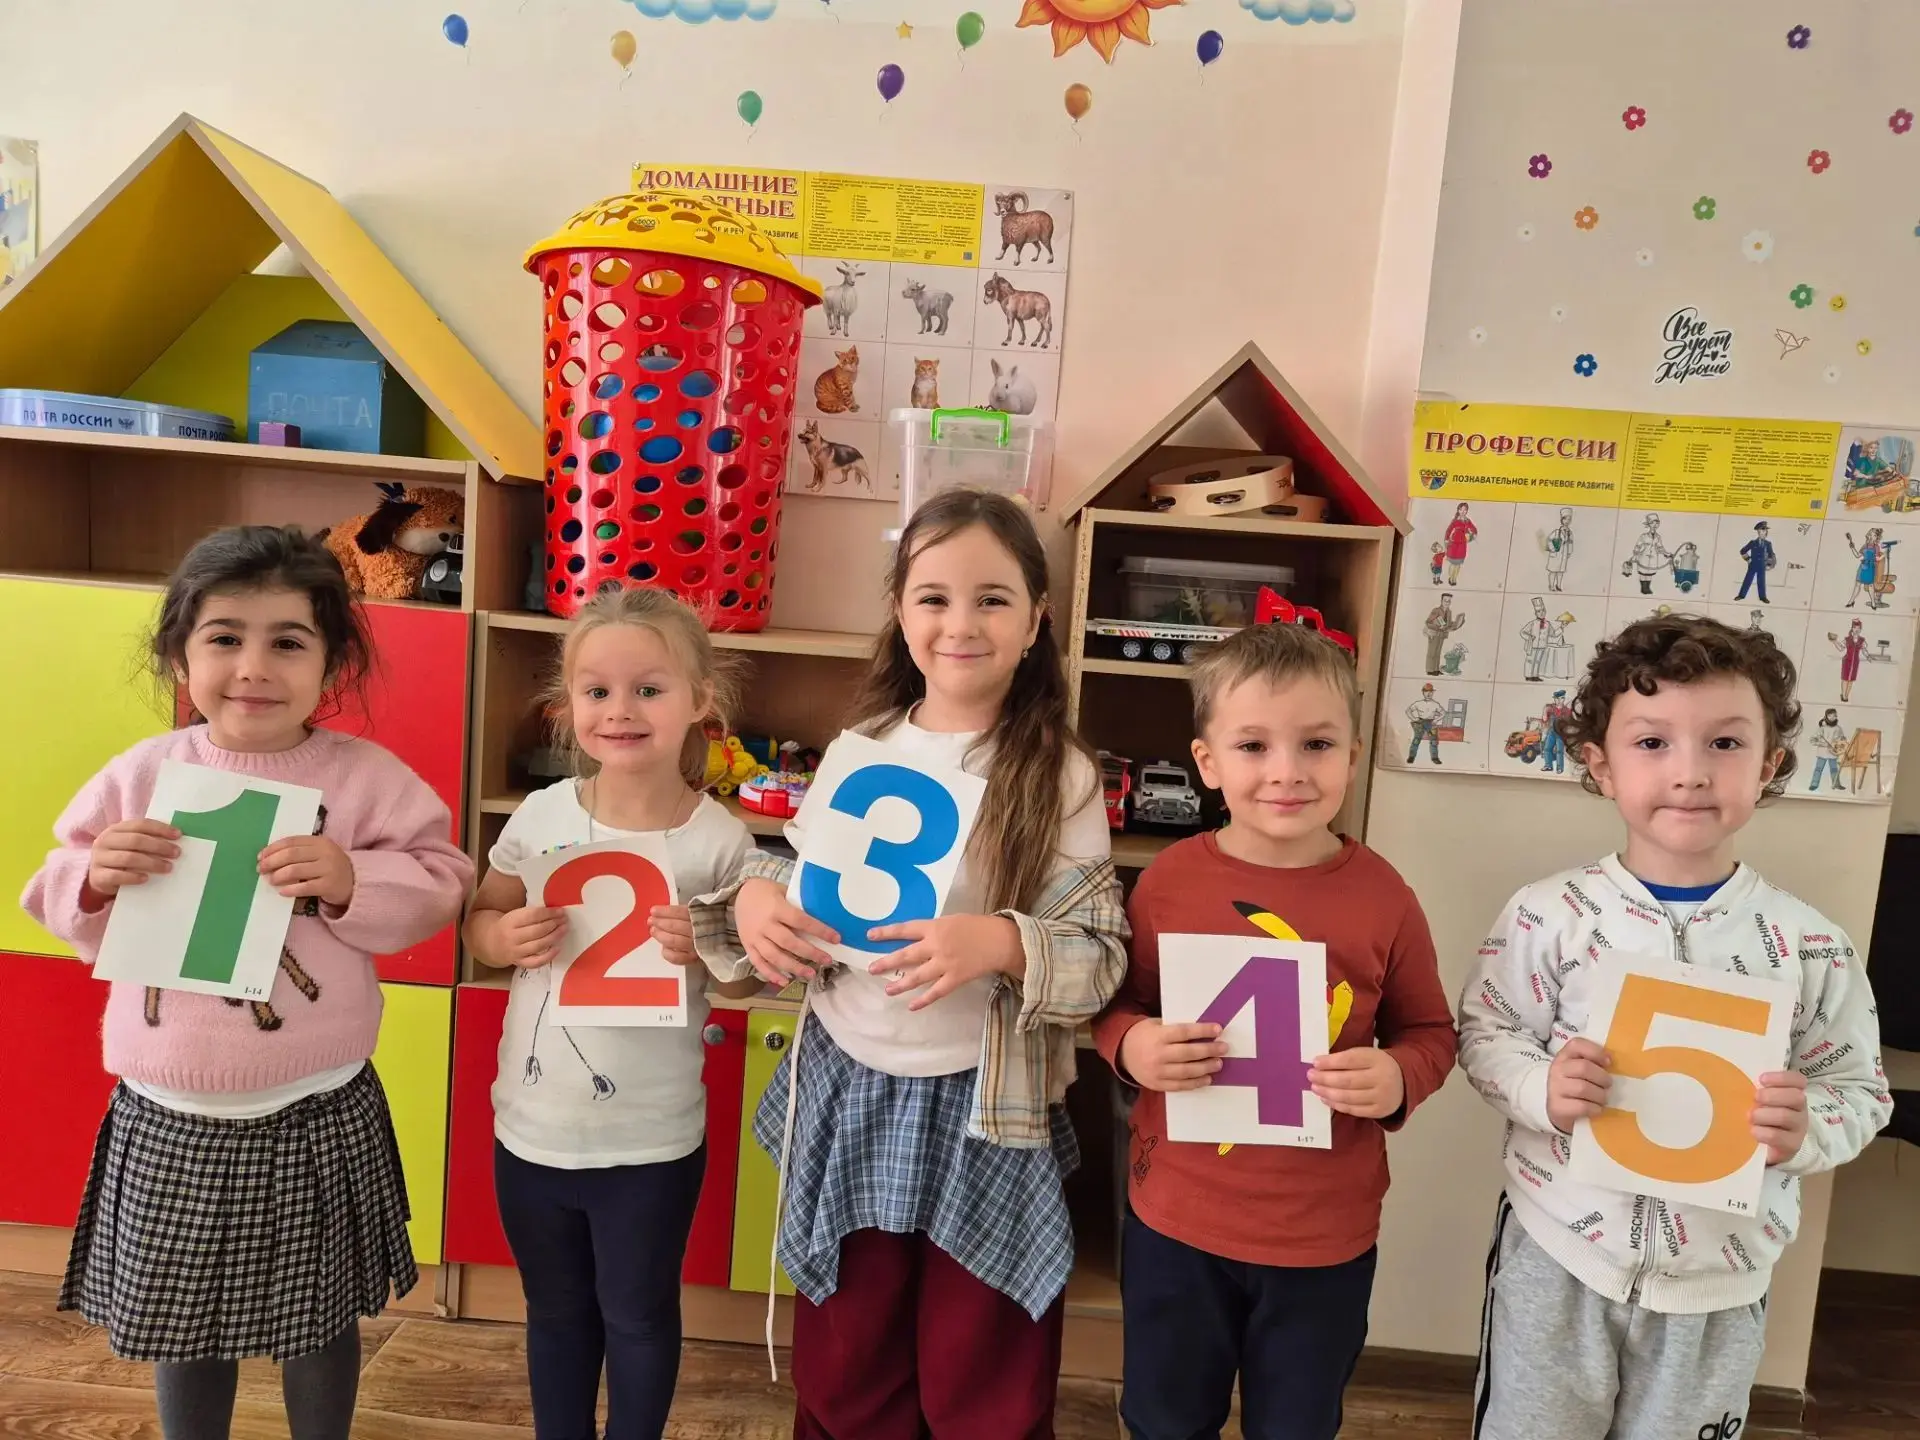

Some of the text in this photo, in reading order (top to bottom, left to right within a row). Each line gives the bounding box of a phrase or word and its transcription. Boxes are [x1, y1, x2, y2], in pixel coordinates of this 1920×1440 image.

[638, 170, 799, 197] ДОМАШНИЕ
[62, 413, 113, 427] РОССИИ
[178, 425, 207, 439] ПОЧТА
[1425, 432, 1617, 462] ПРОФЕССИИ
[1452, 475, 1528, 486] ПОЗНАВАТЕЛЬНОЕ
[1539, 479, 1575, 488] РЕЧЕВОЕ
[1577, 481, 1615, 491] РАЗВИТИЕ
[800, 763, 960, 954] 3
[169, 788, 281, 984] 1
[1564, 879, 1603, 917] MOSCHINO
[1561, 892, 1584, 918] Milano
[1625, 905, 1659, 926] Milano
[543, 850, 680, 1007] 2
[1754, 912, 1782, 969] MOSCHINO
[1771, 923, 1790, 958] Milano
[1482, 978, 1521, 1021] MOSCHINO
[1530, 972, 1544, 1004] Milano
[1191, 956, 1316, 1128] 4
[1800, 1039, 1834, 1061] Milano
[1799, 1042, 1854, 1077] MOSCHINO
[1588, 972, 1772, 1184] 5
[1514, 1150, 1552, 1182] MOSCHINO
[1727, 1199, 1748, 1210] I-18
[1629, 1194, 1646, 1250] MOSCHINO
[1657, 1198, 1681, 1258] MOSCHINO
[1674, 1213, 1689, 1246] Milano
